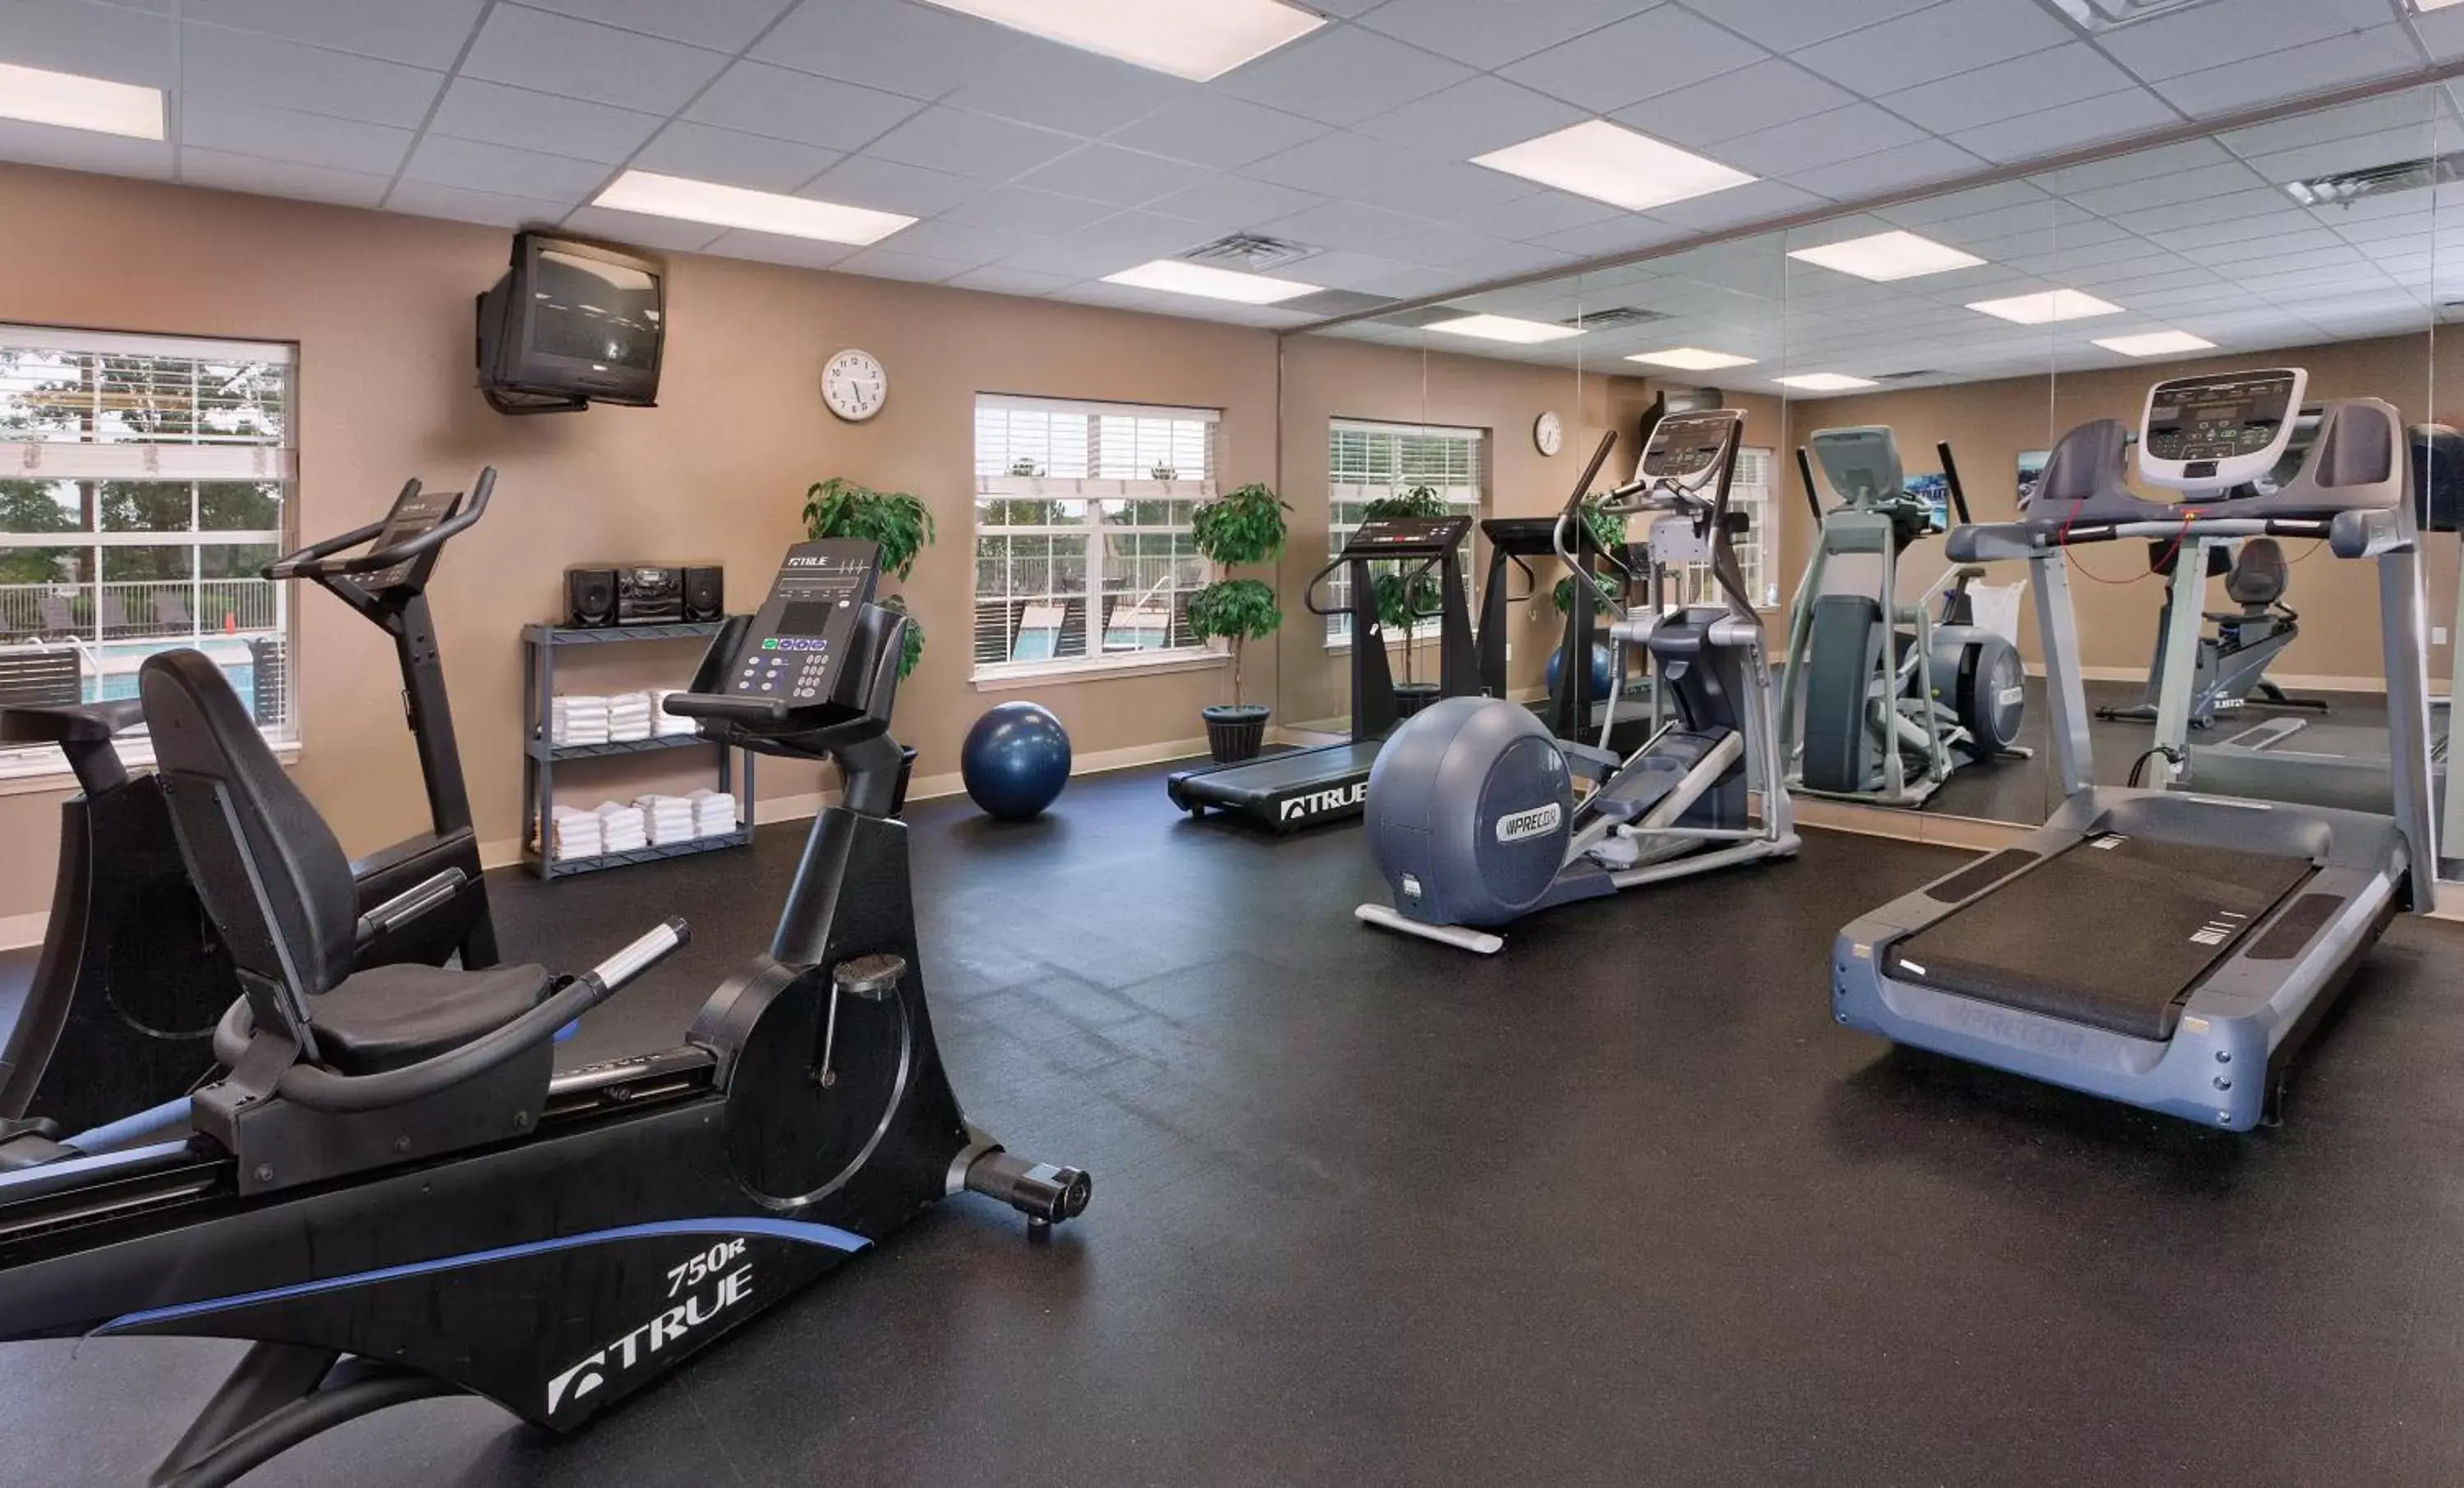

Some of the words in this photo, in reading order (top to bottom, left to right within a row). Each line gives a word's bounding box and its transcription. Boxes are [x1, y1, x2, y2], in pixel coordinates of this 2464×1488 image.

[1306, 782, 1368, 814] TRUE
[1515, 809, 1556, 834] PRECOR
[667, 1237, 747, 1298] 750R
[609, 1262, 753, 1369] TRUE
